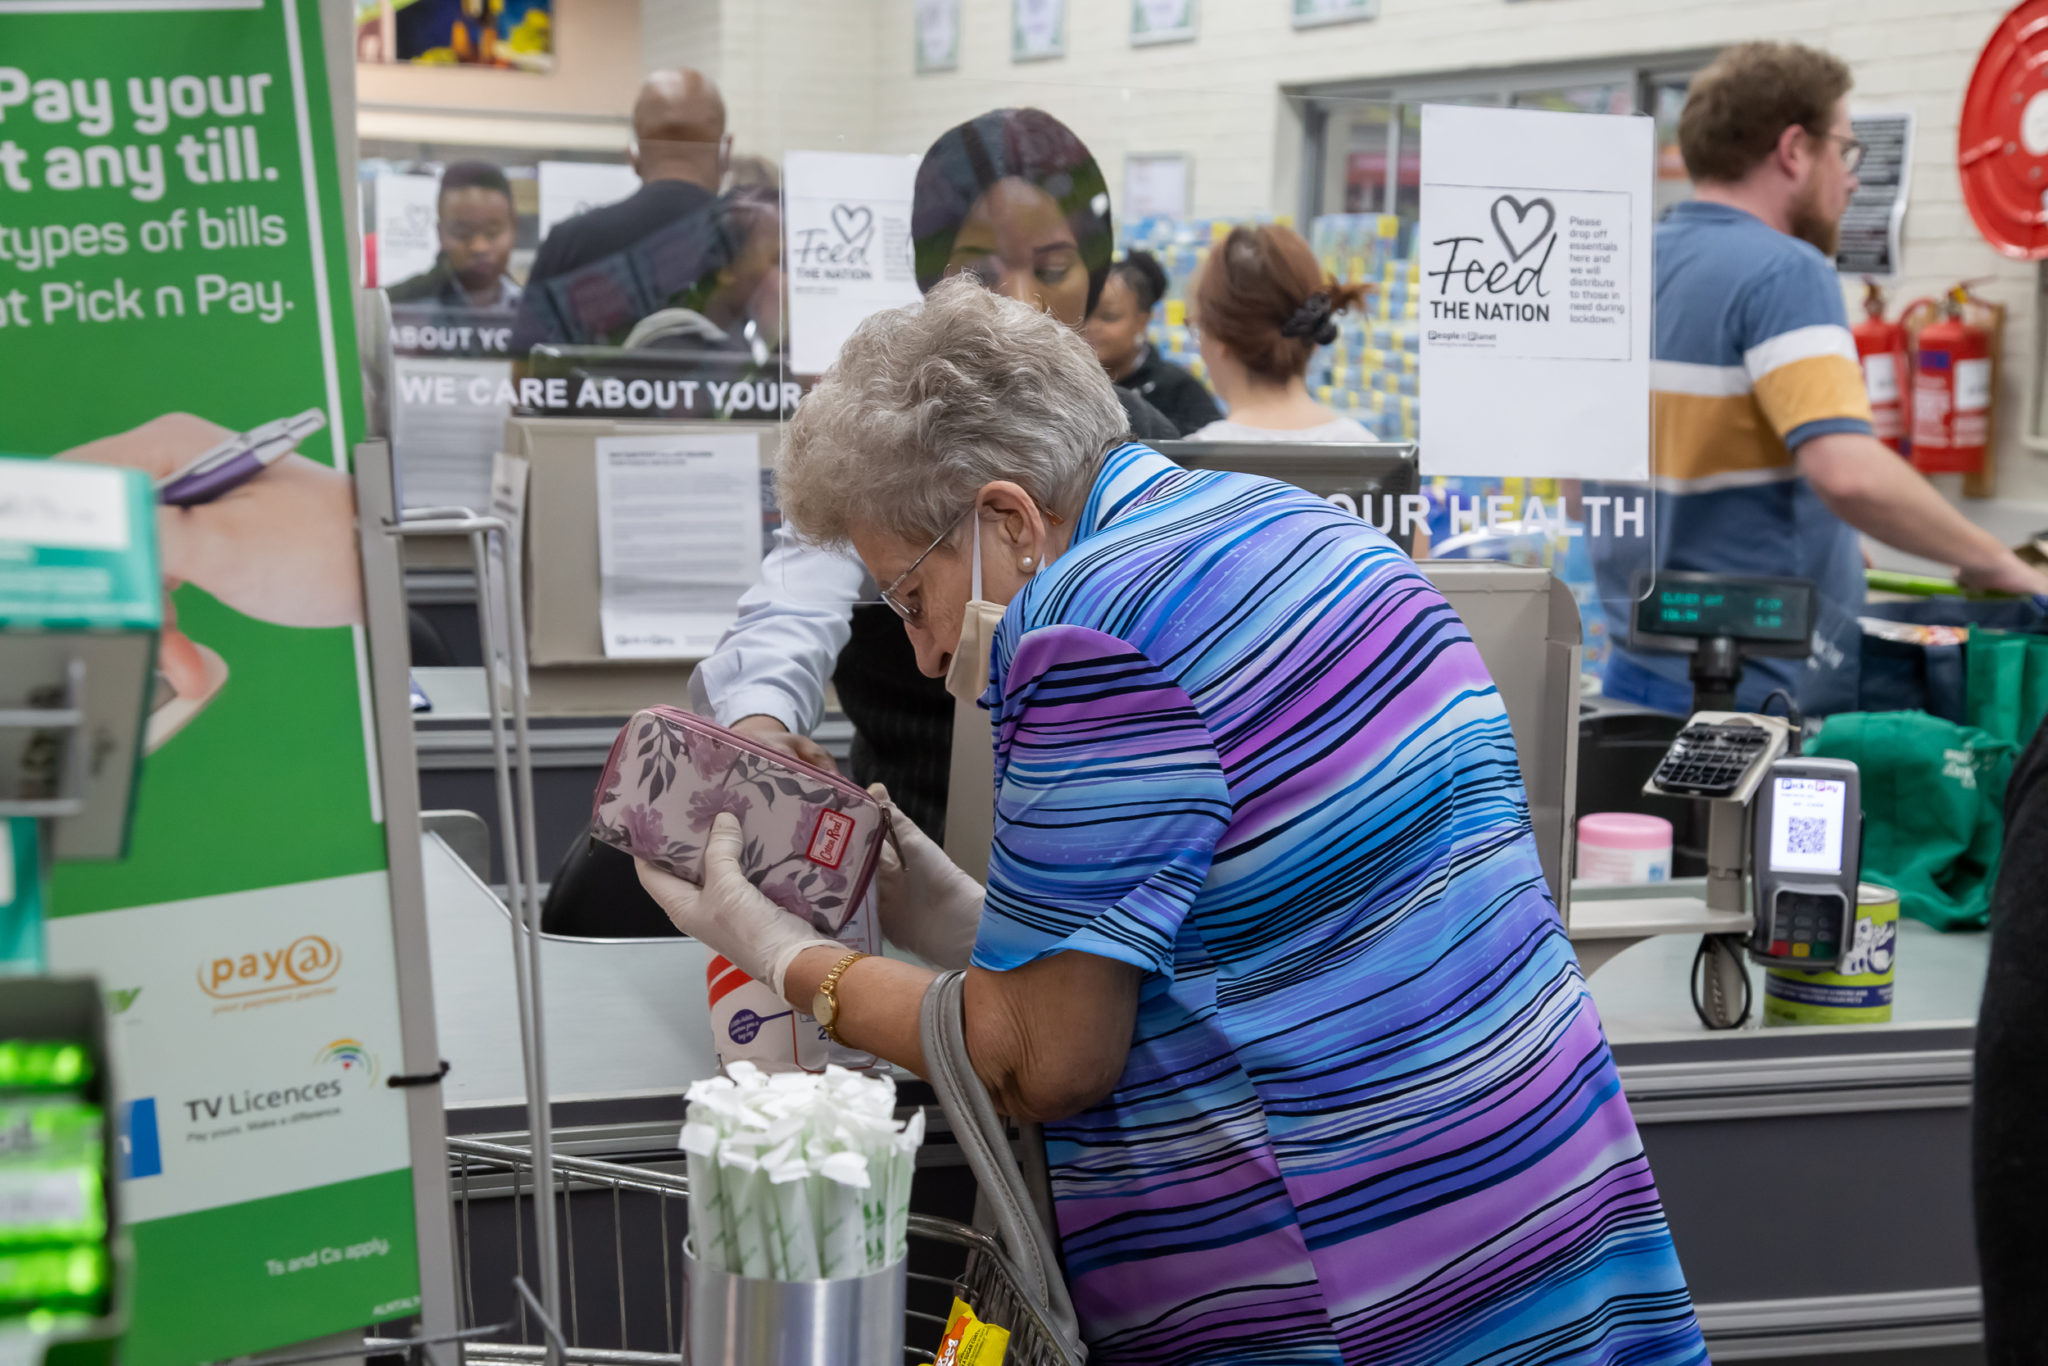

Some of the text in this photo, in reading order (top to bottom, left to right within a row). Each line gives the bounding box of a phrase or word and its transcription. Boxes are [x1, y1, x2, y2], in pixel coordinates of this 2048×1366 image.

[0, 67, 272, 136] Pay your
[44, 145, 166, 201] any
[176, 125, 279, 184] till.
[1569, 216, 1602, 226] Please
[0, 205, 287, 271] types of bills
[793, 224, 875, 266] Feed
[1569, 229, 1608, 239] drop off
[1569, 242, 1618, 251] essentials
[1569, 254, 1611, 263] here and
[796, 268, 873, 281] THE NATION
[1428, 231, 1557, 297] Feed
[1586, 266, 1601, 275] will
[1569, 279, 1616, 288] distribute
[1569, 291, 1620, 300] to those in
[0, 274, 294, 328] t Pick n Pay.
[1430, 300, 1550, 322] THE NATION
[1569, 303, 1626, 315] need during
[389, 326, 473, 350] ABOUT
[401, 376, 802, 412] WE CARE ABOUT YOUR
[1450, 494, 1645, 538] HEALTH
[184, 1079, 342, 1122] TV Licences
[265, 1258, 285, 1276] Ts
[287, 1251, 318, 1273] and
[320, 1247, 342, 1265] Cs
